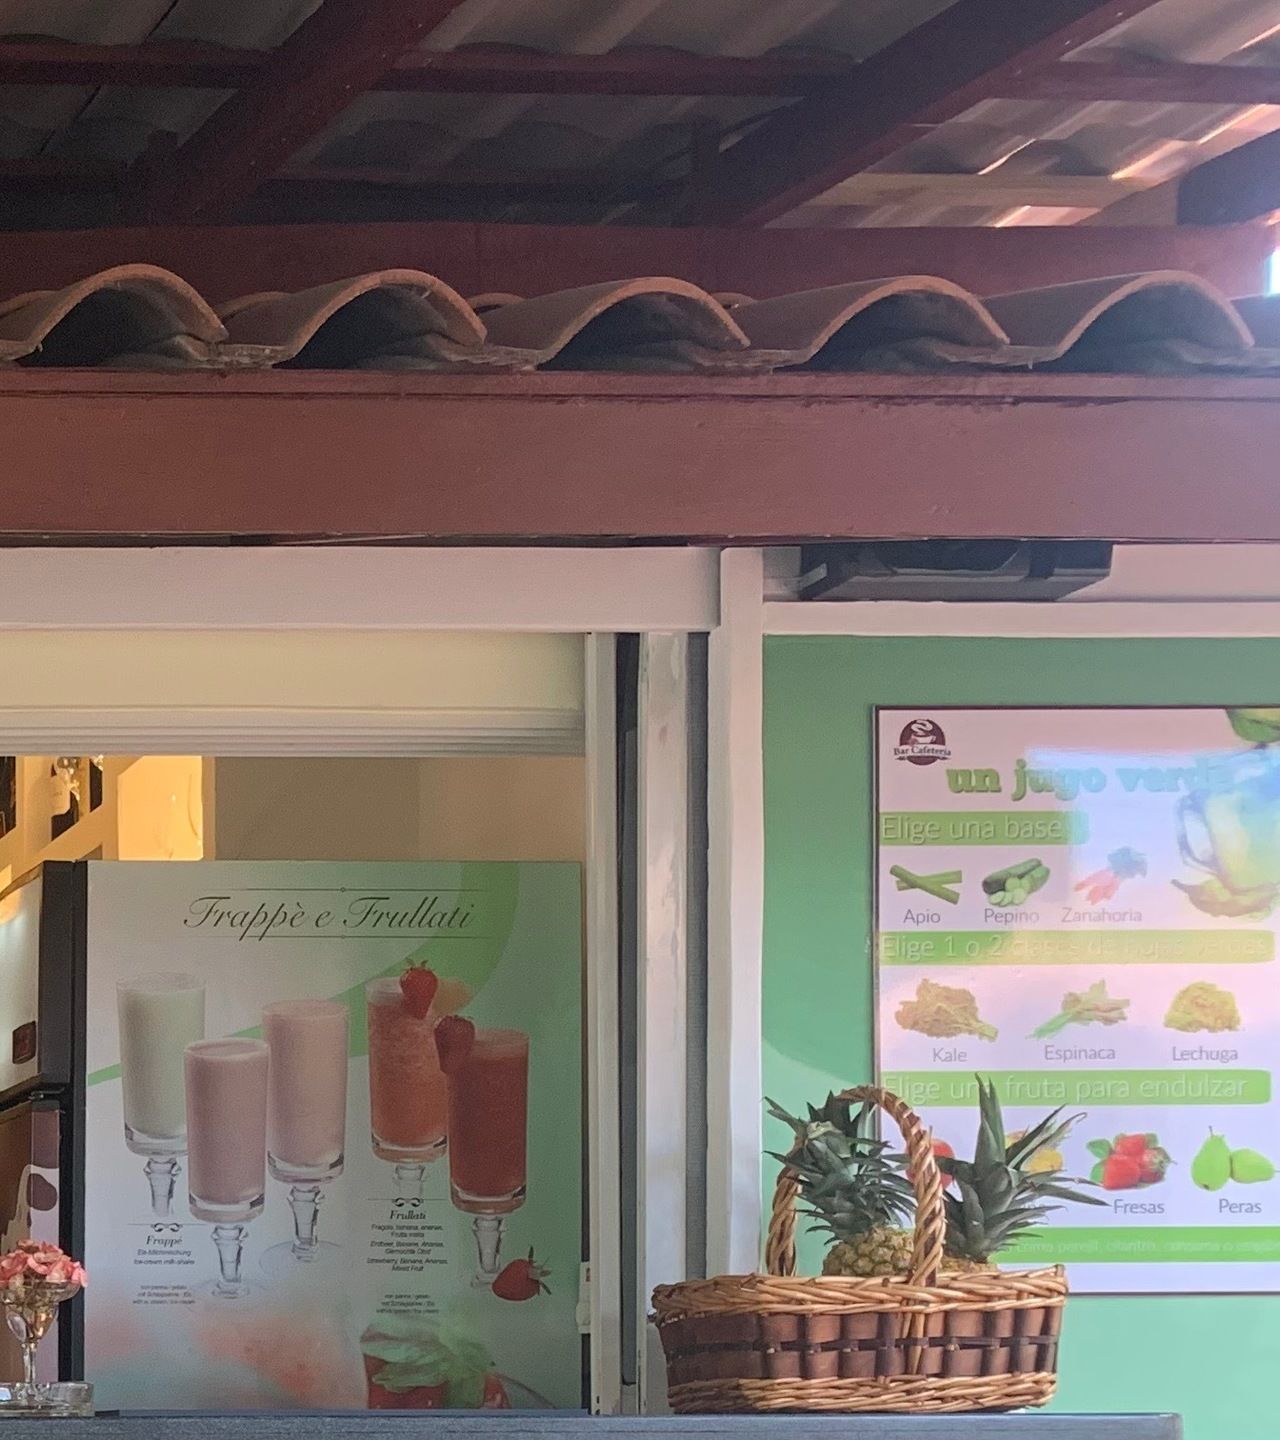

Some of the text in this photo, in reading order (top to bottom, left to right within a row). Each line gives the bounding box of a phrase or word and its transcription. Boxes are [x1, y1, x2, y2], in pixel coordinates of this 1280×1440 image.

[893, 744, 952, 757] Bar Cafeteria
[946, 766, 1002, 794] un
[1011, 758, 1108, 802] jugo
[881, 814, 1063, 842] Elige una base
[314, 910, 336, 930] e
[342, 896, 474, 930] Frullati
[903, 908, 941, 926] Apio
[983, 907, 1040, 926] Pepino
[1060, 906, 1143, 924] Zanahoria
[881, 935, 936, 959] Elige
[943, 936, 958, 956] 1
[965, 940, 981, 957] o
[988, 935, 1003, 957] 2
[932, 1047, 968, 1063] Kale
[1044, 1044, 1116, 1064] Espinaca
[1172, 1046, 1239, 1064] Lechuga
[883, 1075, 940, 1104] Elige
[1006, 1075, 1066, 1099] fruta
[1076, 1080, 1130, 1103] para
[1141, 1074, 1249, 1099] endulzar
[1113, 1199, 1166, 1215] Fresas
[1218, 1199, 1263, 1214] Peras
